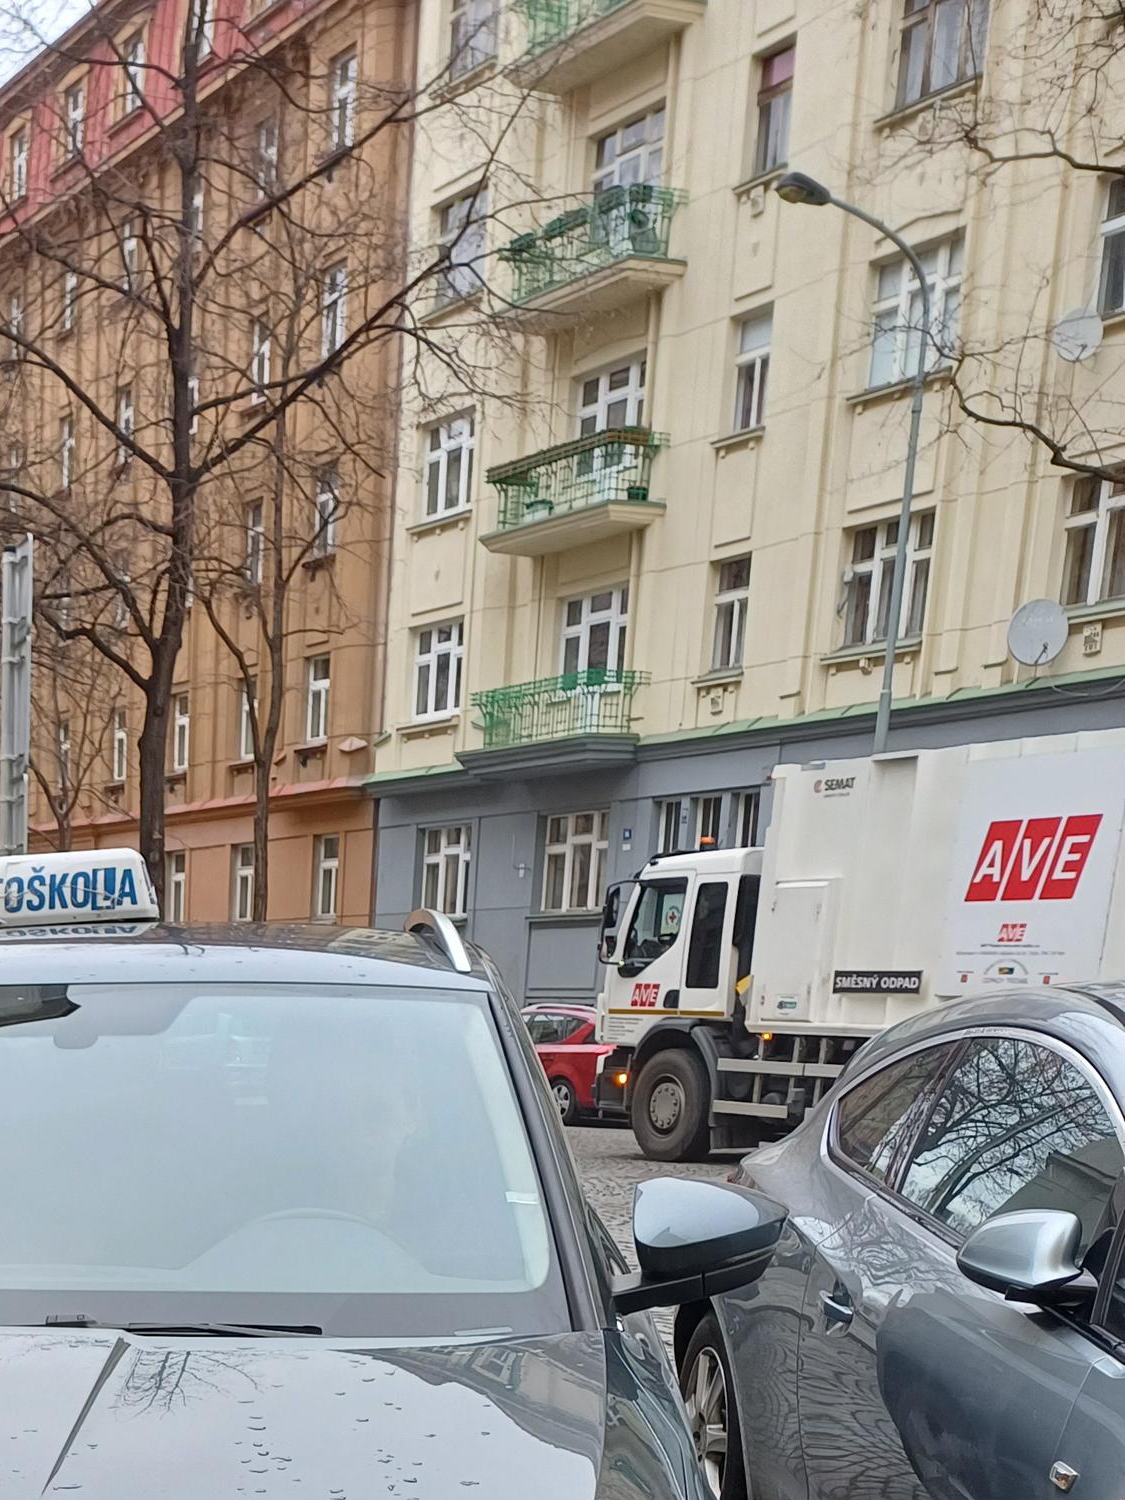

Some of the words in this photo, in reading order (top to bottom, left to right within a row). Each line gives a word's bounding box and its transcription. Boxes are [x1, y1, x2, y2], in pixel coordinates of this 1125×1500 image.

[824, 777, 855, 791] SEMAT
[971, 831, 1093, 886] AVE
[998, 925, 1025, 941] AVE
[835, 974, 878, 989] SMĚSNÝ
[880, 976, 919, 989] ODPAD
[632, 986, 659, 1004] AVE
